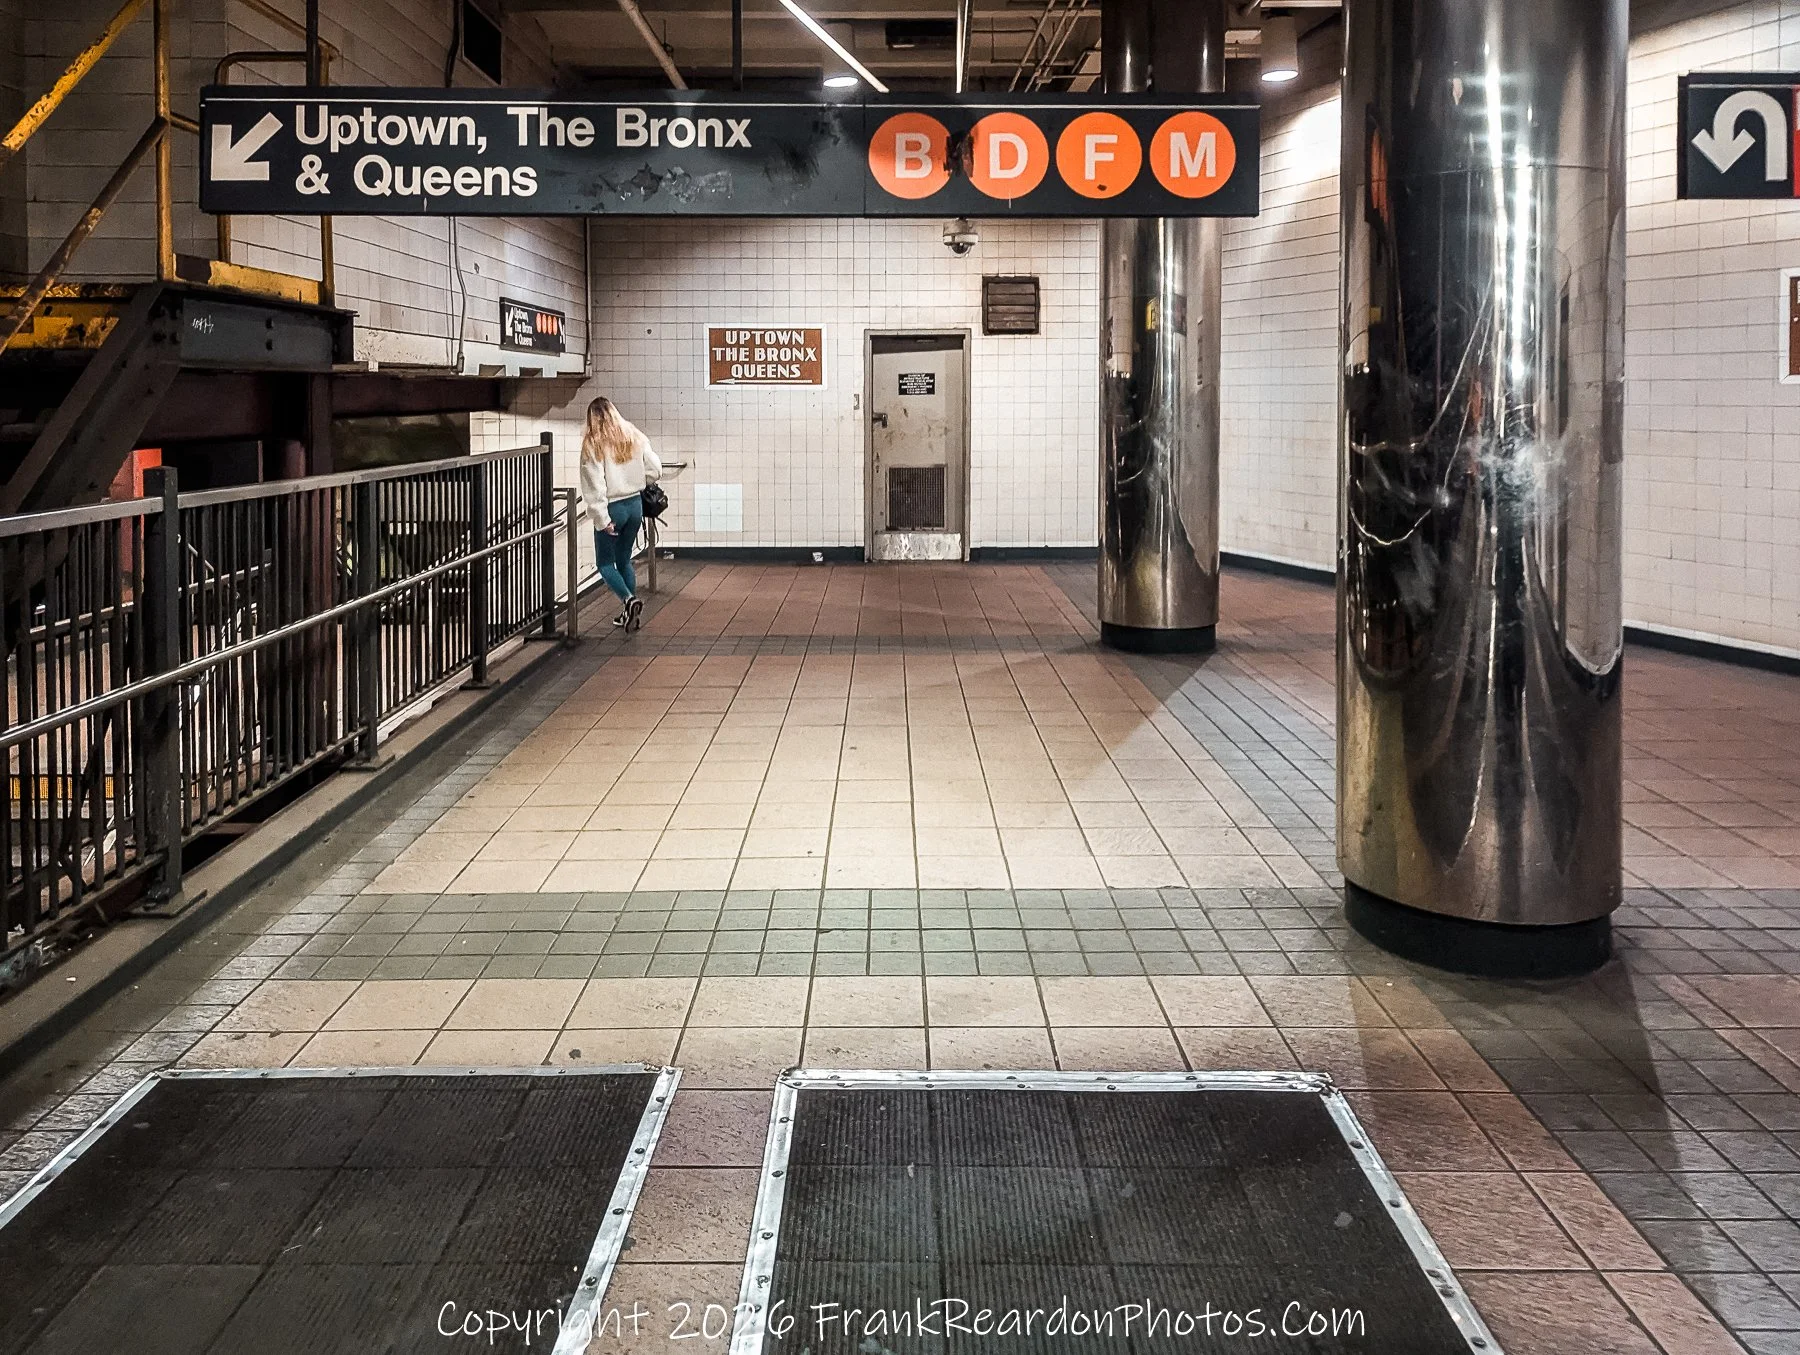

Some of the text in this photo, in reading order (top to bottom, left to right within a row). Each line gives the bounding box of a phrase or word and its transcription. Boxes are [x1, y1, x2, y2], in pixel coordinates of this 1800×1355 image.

[295, 104, 752, 155] Uptown, The Bronx
[894, 131, 1217, 180] B D F M
[295, 153, 538, 197] & Queens
[725, 330, 804, 345] UPTOWN
[712, 347, 818, 362] THE BRONX
[731, 364, 801, 378] QUEENS
